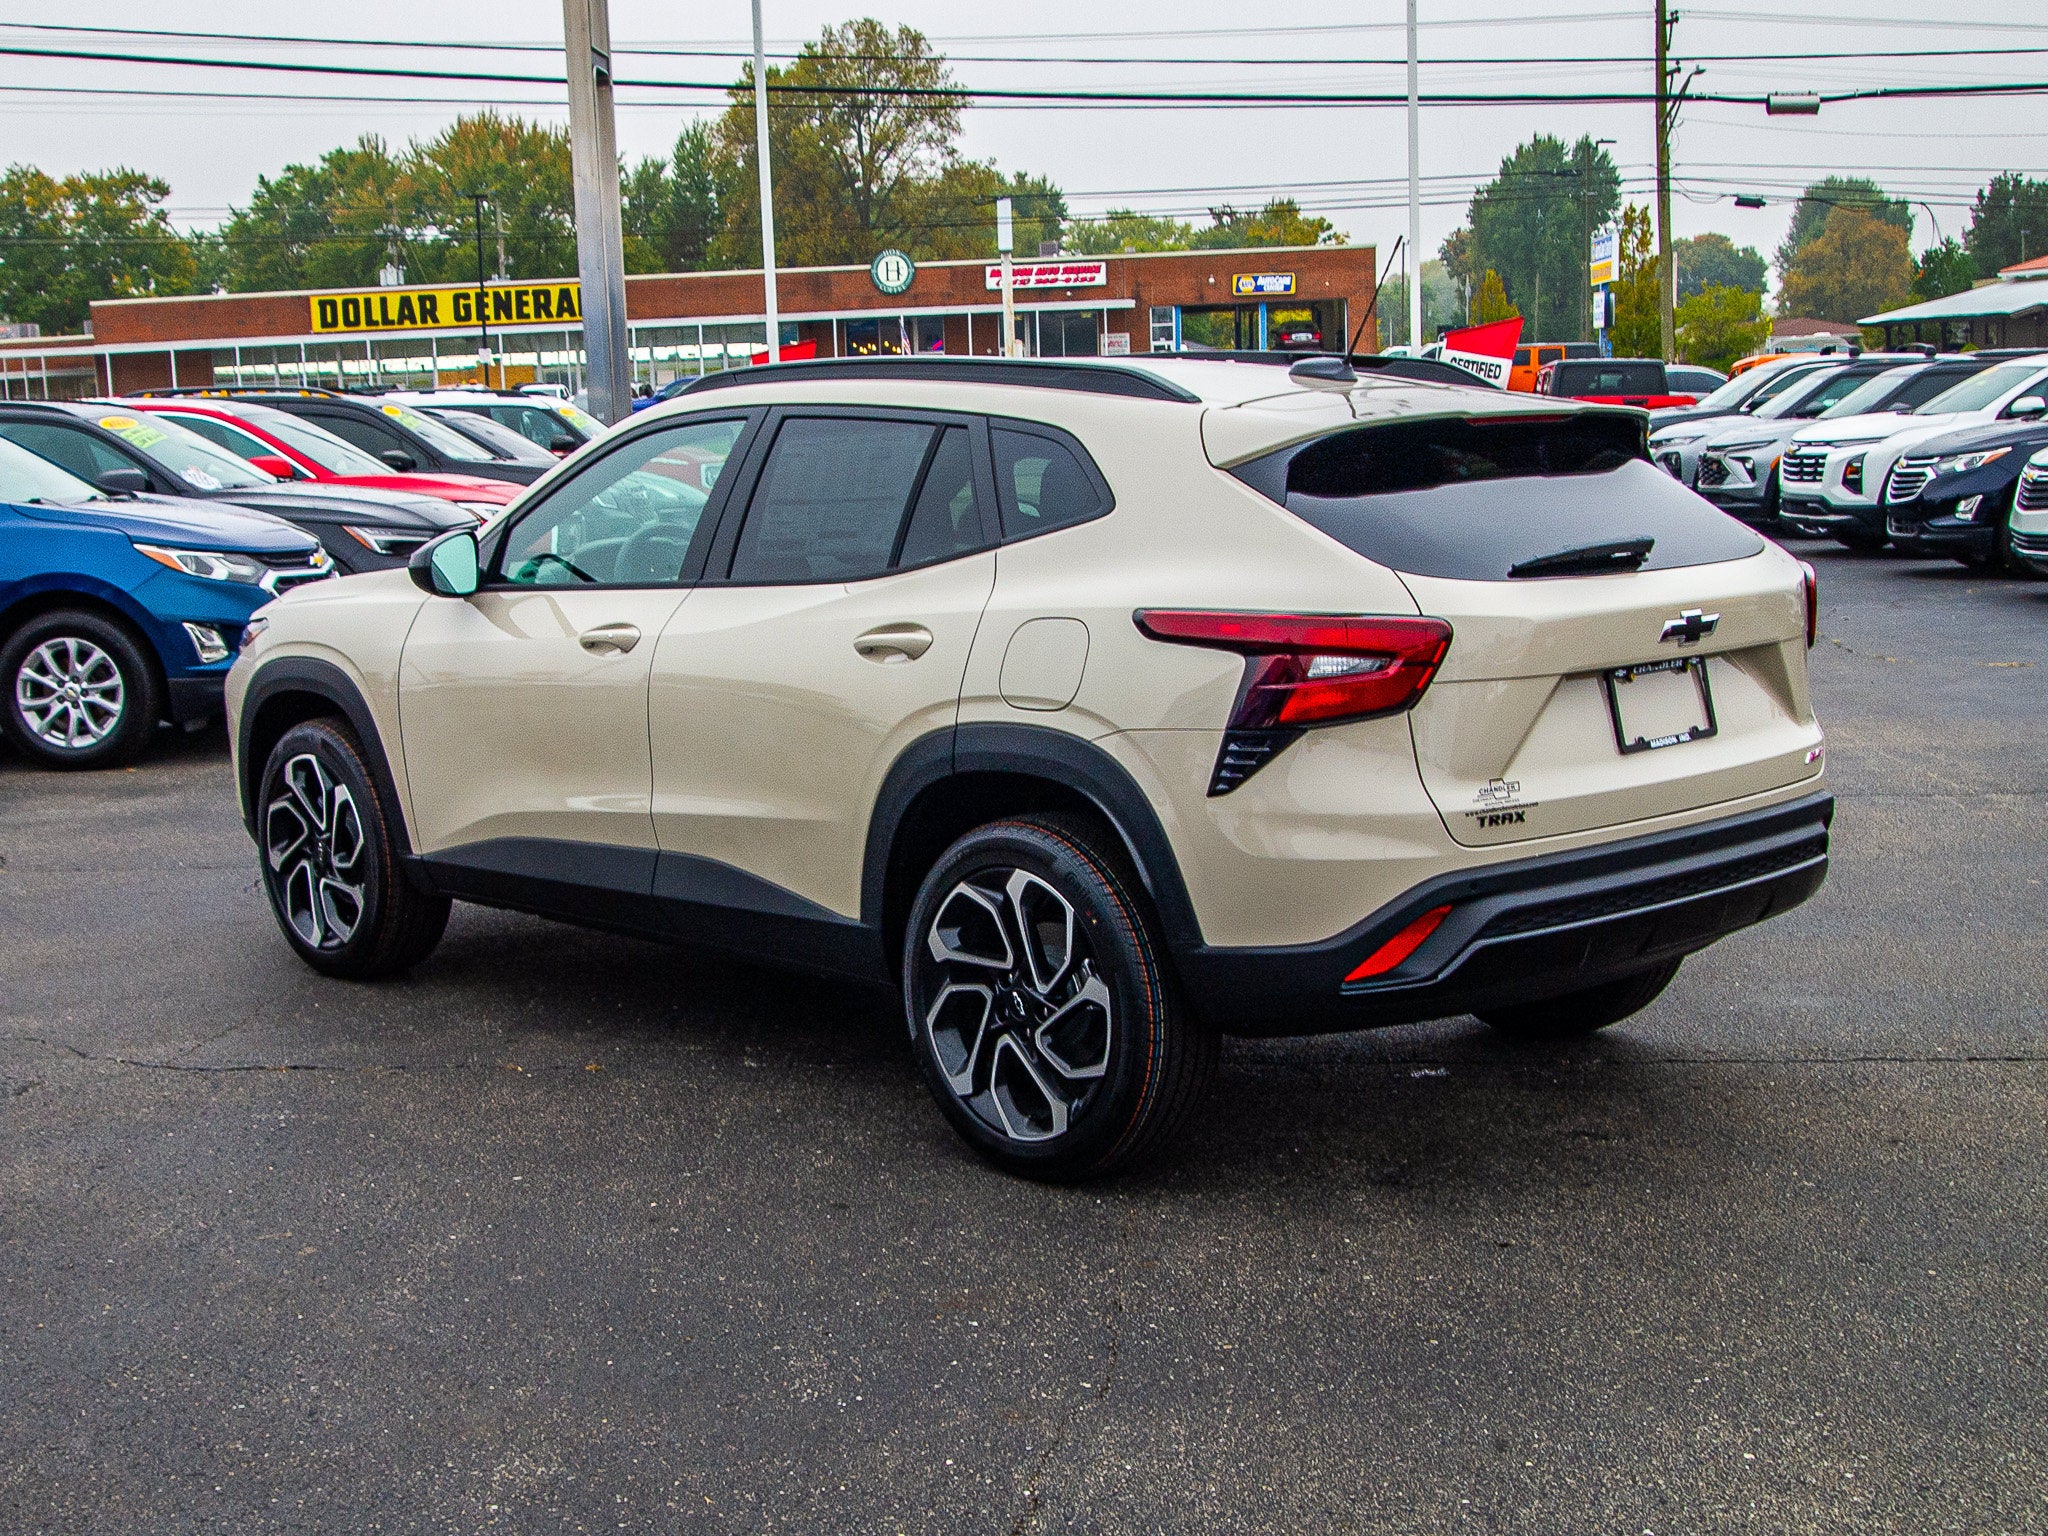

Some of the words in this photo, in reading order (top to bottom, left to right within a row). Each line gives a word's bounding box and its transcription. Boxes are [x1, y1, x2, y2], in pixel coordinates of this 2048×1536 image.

[885, 261, 900, 281] H
[991, 268, 1032, 277] MASON
[318, 294, 440, 329] DOLLAR
[453, 286, 582, 322] GENERA
[1650, 735, 1679, 748] MADISON
[1478, 783, 1516, 794] CHANDLER
[1476, 809, 1526, 829] TRAX
